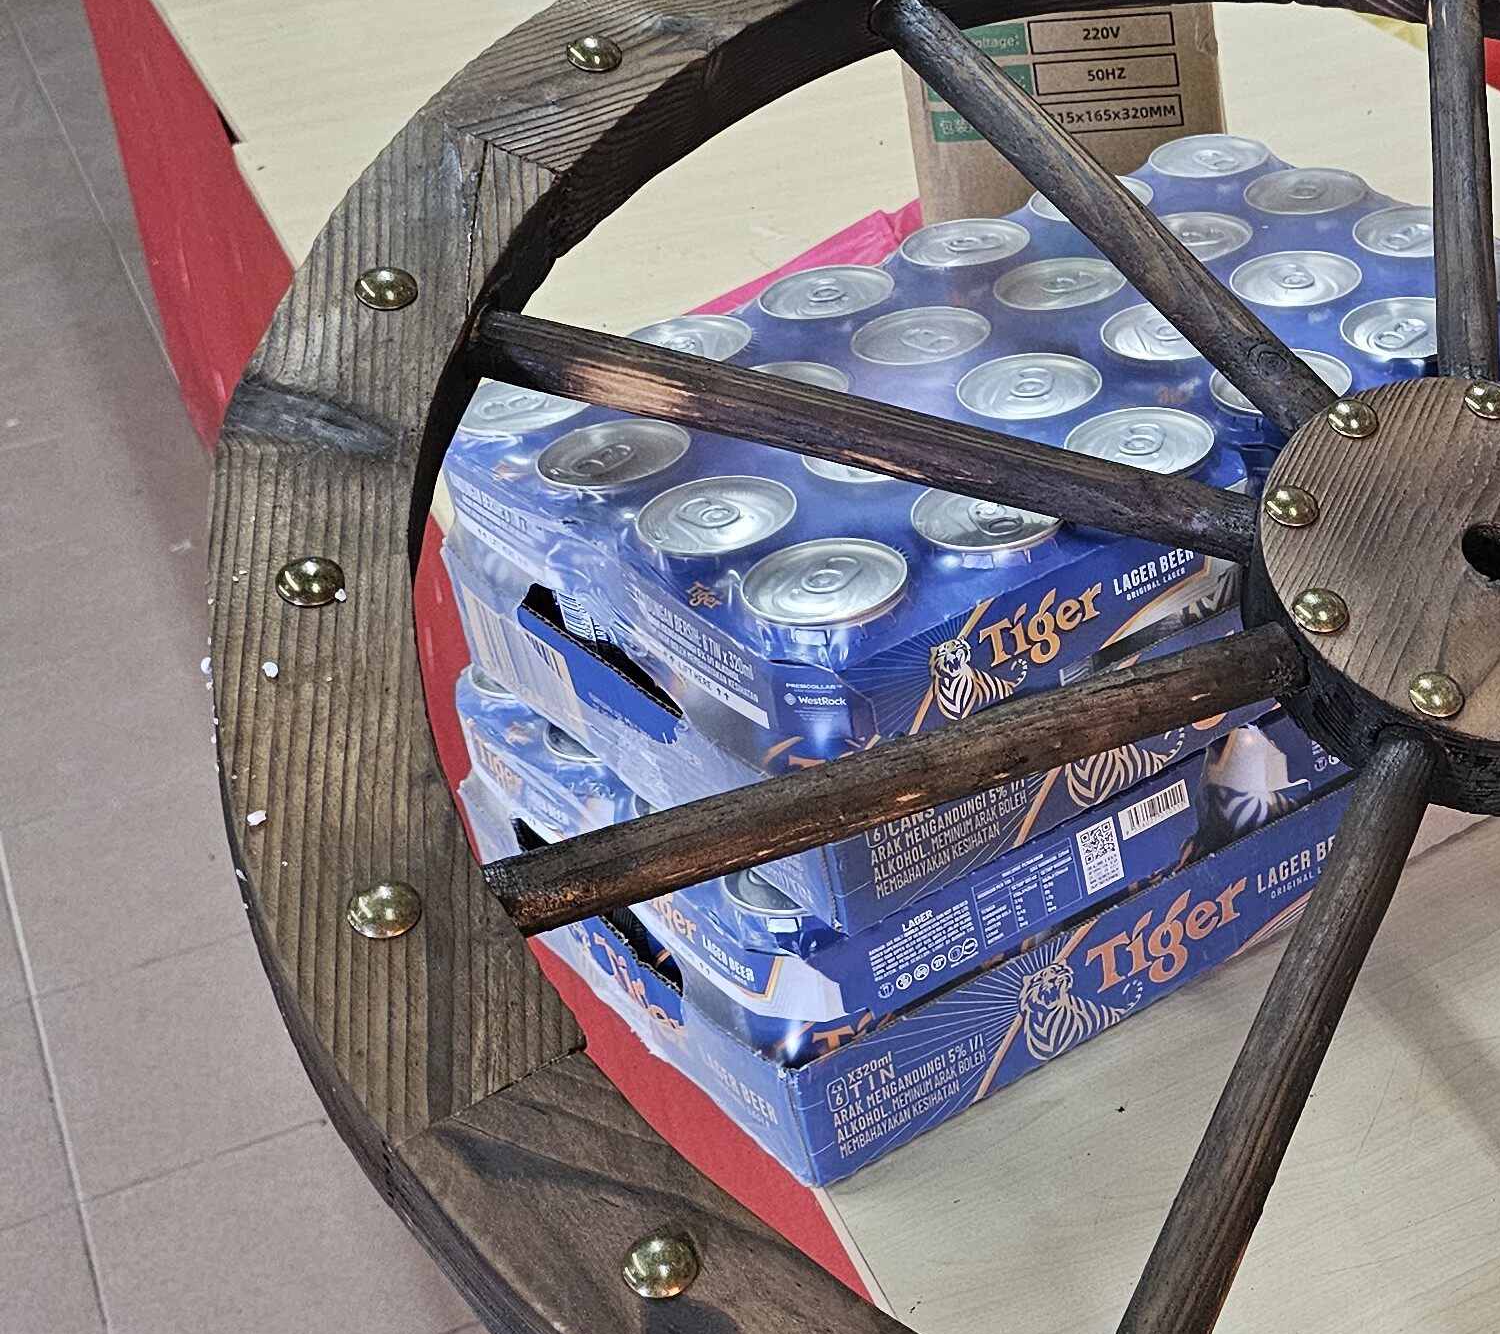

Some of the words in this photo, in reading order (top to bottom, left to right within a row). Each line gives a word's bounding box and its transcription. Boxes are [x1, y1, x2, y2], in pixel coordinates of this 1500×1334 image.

[972, 33, 1020, 48] oltage:
[1082, 26, 1121, 41] 220V
[1087, 67, 1127, 82] 50HZ
[1050, 104, 1177, 125] 15x165x320MM
[1113, 559, 1157, 596] LAGER
[1126, 579, 1161, 602] ORIGINAL
[1163, 567, 1186, 584] LAGER
[979, 581, 1102, 666] Tiger
[797, 695, 848, 706] WestRock
[870, 837, 903, 866] ARAK
[905, 793, 987, 847] MENGANDUNGI
[931, 823, 974, 853] MEMINUM
[973, 807, 999, 830] ARAK
[998, 788, 1028, 817] BOLEH
[875, 851, 951, 900] MEMBAHAYAKAN
[951, 822, 1001, 865] KESIHATAN
[1257, 849, 1311, 894] LAGER
[1270, 871, 1314, 900] ORIGINAL
[901, 909, 934, 933] LAGER
[1085, 875, 1248, 994] Tiger
[739, 1078, 778, 1125] BEER
[833, 1099, 864, 1128] ARAK
[866, 1054, 946, 1110] MENGANDUNGI
[948, 1043, 967, 1063] 5%
[892, 1082, 933, 1110] MEMINUM
[933, 1066, 958, 1088] ARAK
[958, 1048, 987, 1074] BOLEH
[839, 1107, 912, 1159] MEMBAHAYAKAN
[911, 1079, 960, 1117] KESIHATAN
